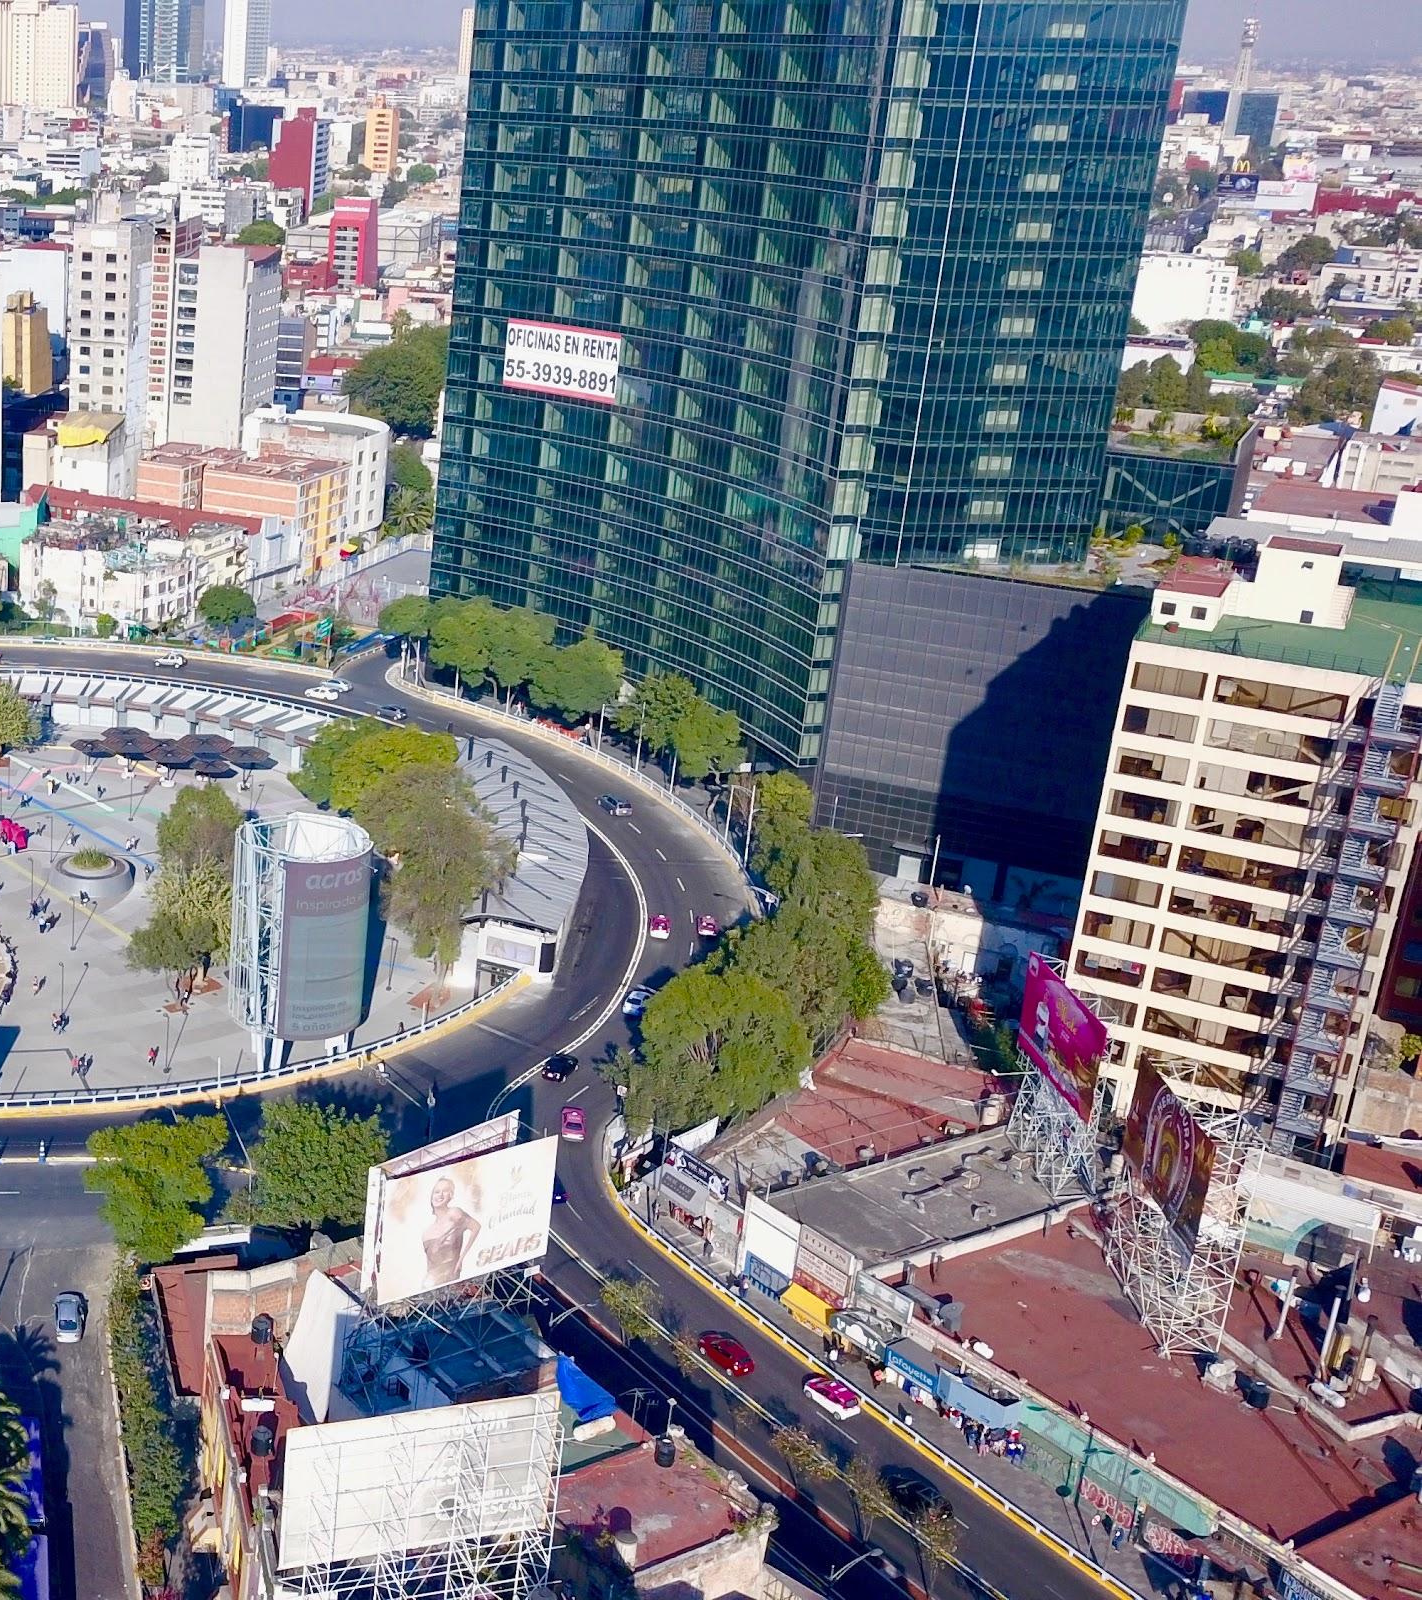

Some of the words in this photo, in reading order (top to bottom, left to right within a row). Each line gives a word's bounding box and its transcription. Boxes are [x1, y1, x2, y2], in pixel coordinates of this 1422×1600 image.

[507, 327, 561, 353] OFICINAS
[564, 335, 580, 355] EN
[583, 337, 618, 362] RENTA
[505, 358, 617, 394] 55-3939-8891
[306, 866, 363, 889] acros
[476, 1232, 542, 1267] SEARS
[888, 1350, 933, 1386] Lafayette
